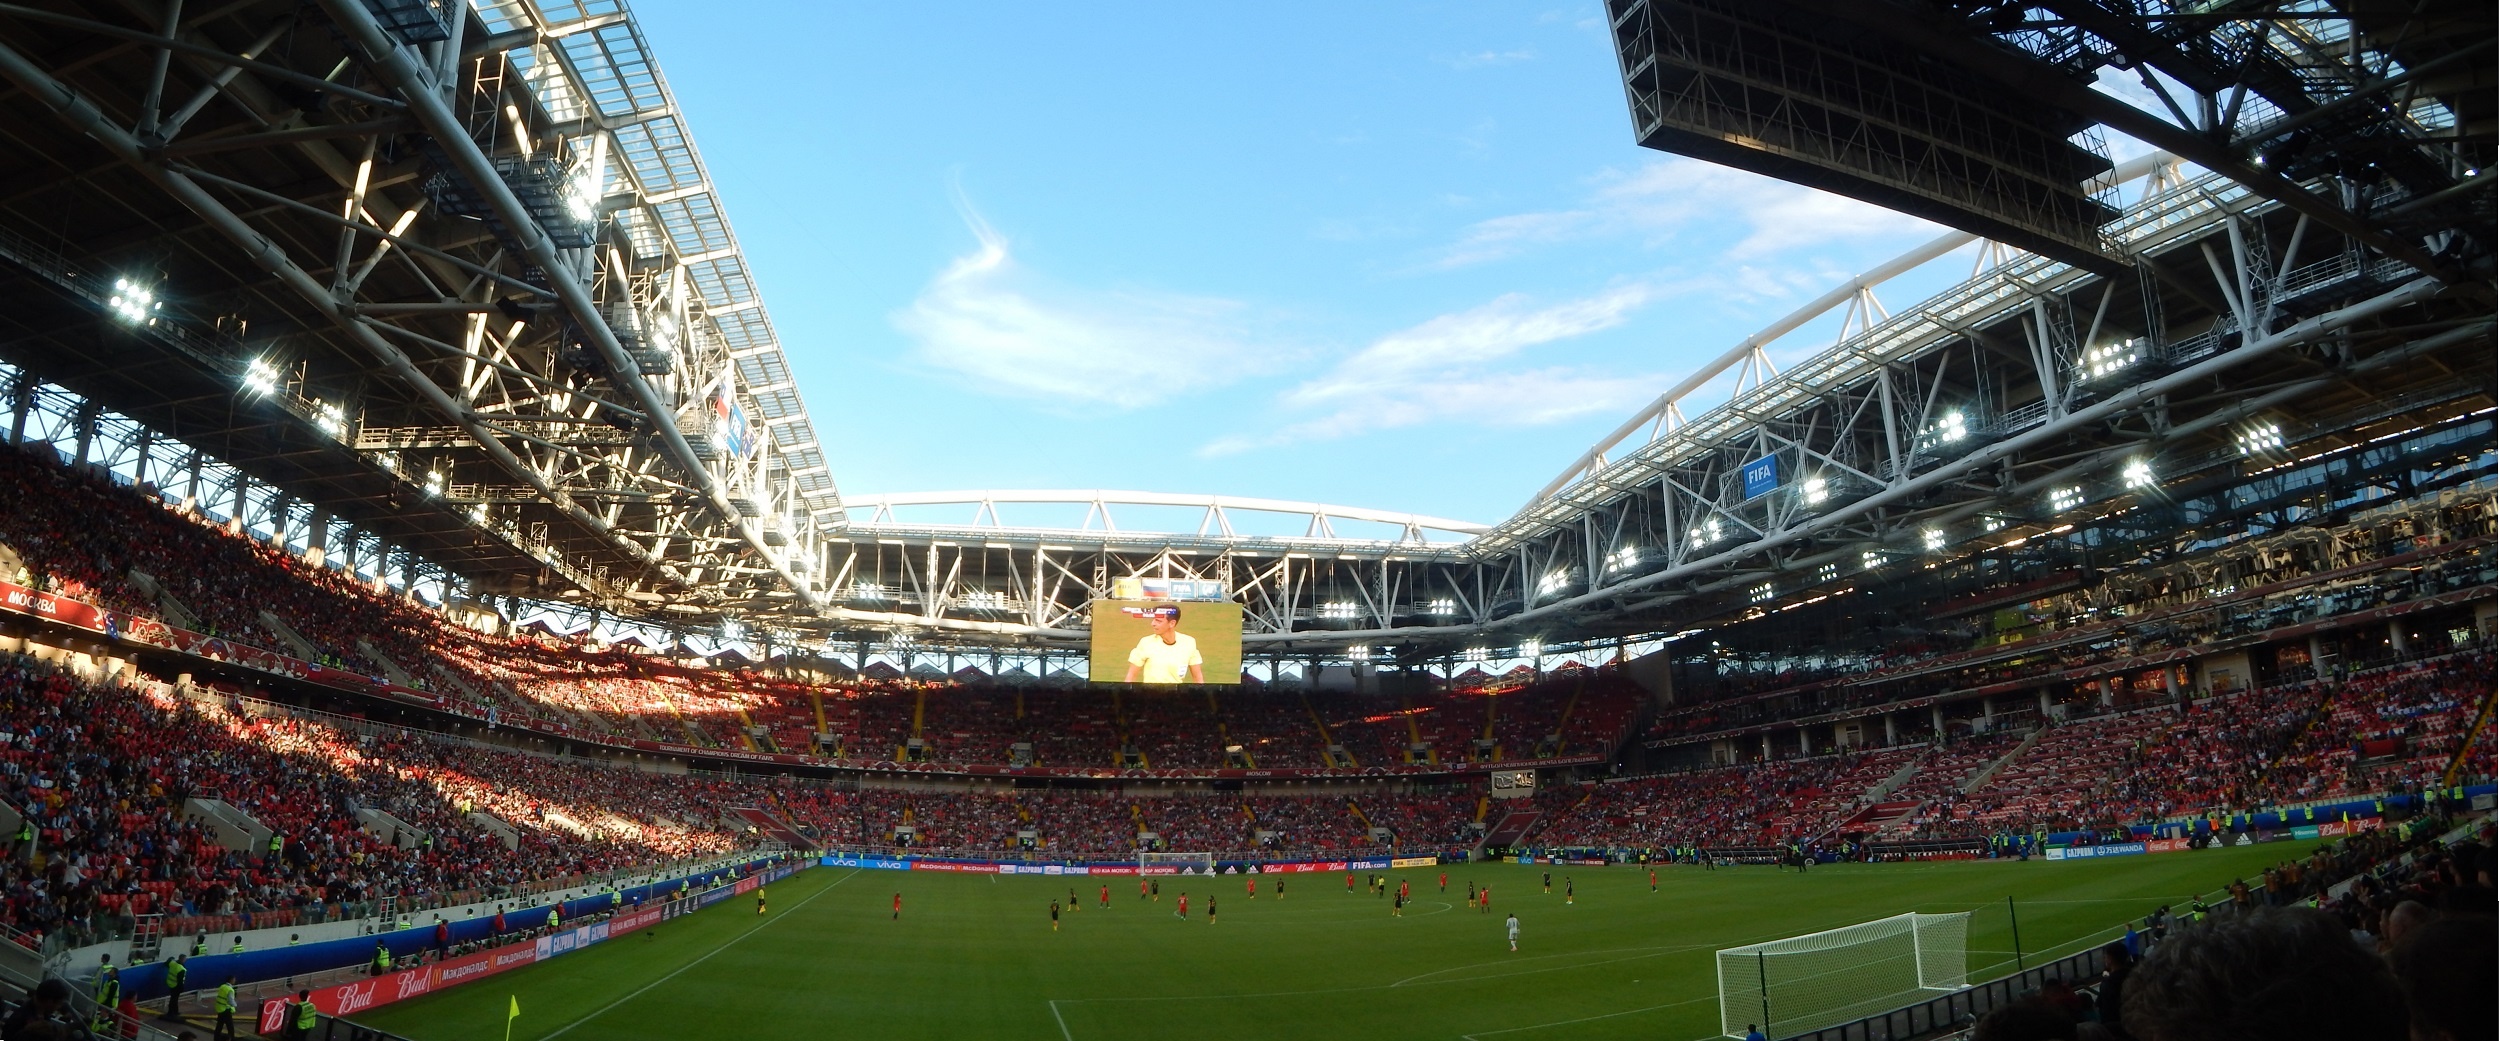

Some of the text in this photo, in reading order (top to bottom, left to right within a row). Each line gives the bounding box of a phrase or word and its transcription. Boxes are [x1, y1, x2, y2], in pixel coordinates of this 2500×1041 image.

[1748, 464, 1771, 485] FIFA
[1173, 584, 1192, 592] FIFA
[8, 591, 56, 613] МОСКВА
[659, 745, 690, 753] TOURNAMENT
[2319, 822, 2346, 836] Bud
[2066, 847, 2094, 858] GAZPROM
[2119, 845, 2144, 853] WANDA
[832, 859, 857, 867] vvo
[919, 863, 956, 871] McDonald's
[1264, 864, 1284, 873] Bud
[1296, 863, 1315, 872] Bud
[1327, 862, 1347, 871] Bud
[1353, 861, 1387, 869] FIFA.com
[1064, 866, 1089, 874] GAZPROM
[442, 947, 535, 981] Макдоналдс Макдоналдс
[337, 981, 376, 1015] Bud
[397, 965, 432, 999] Bud
